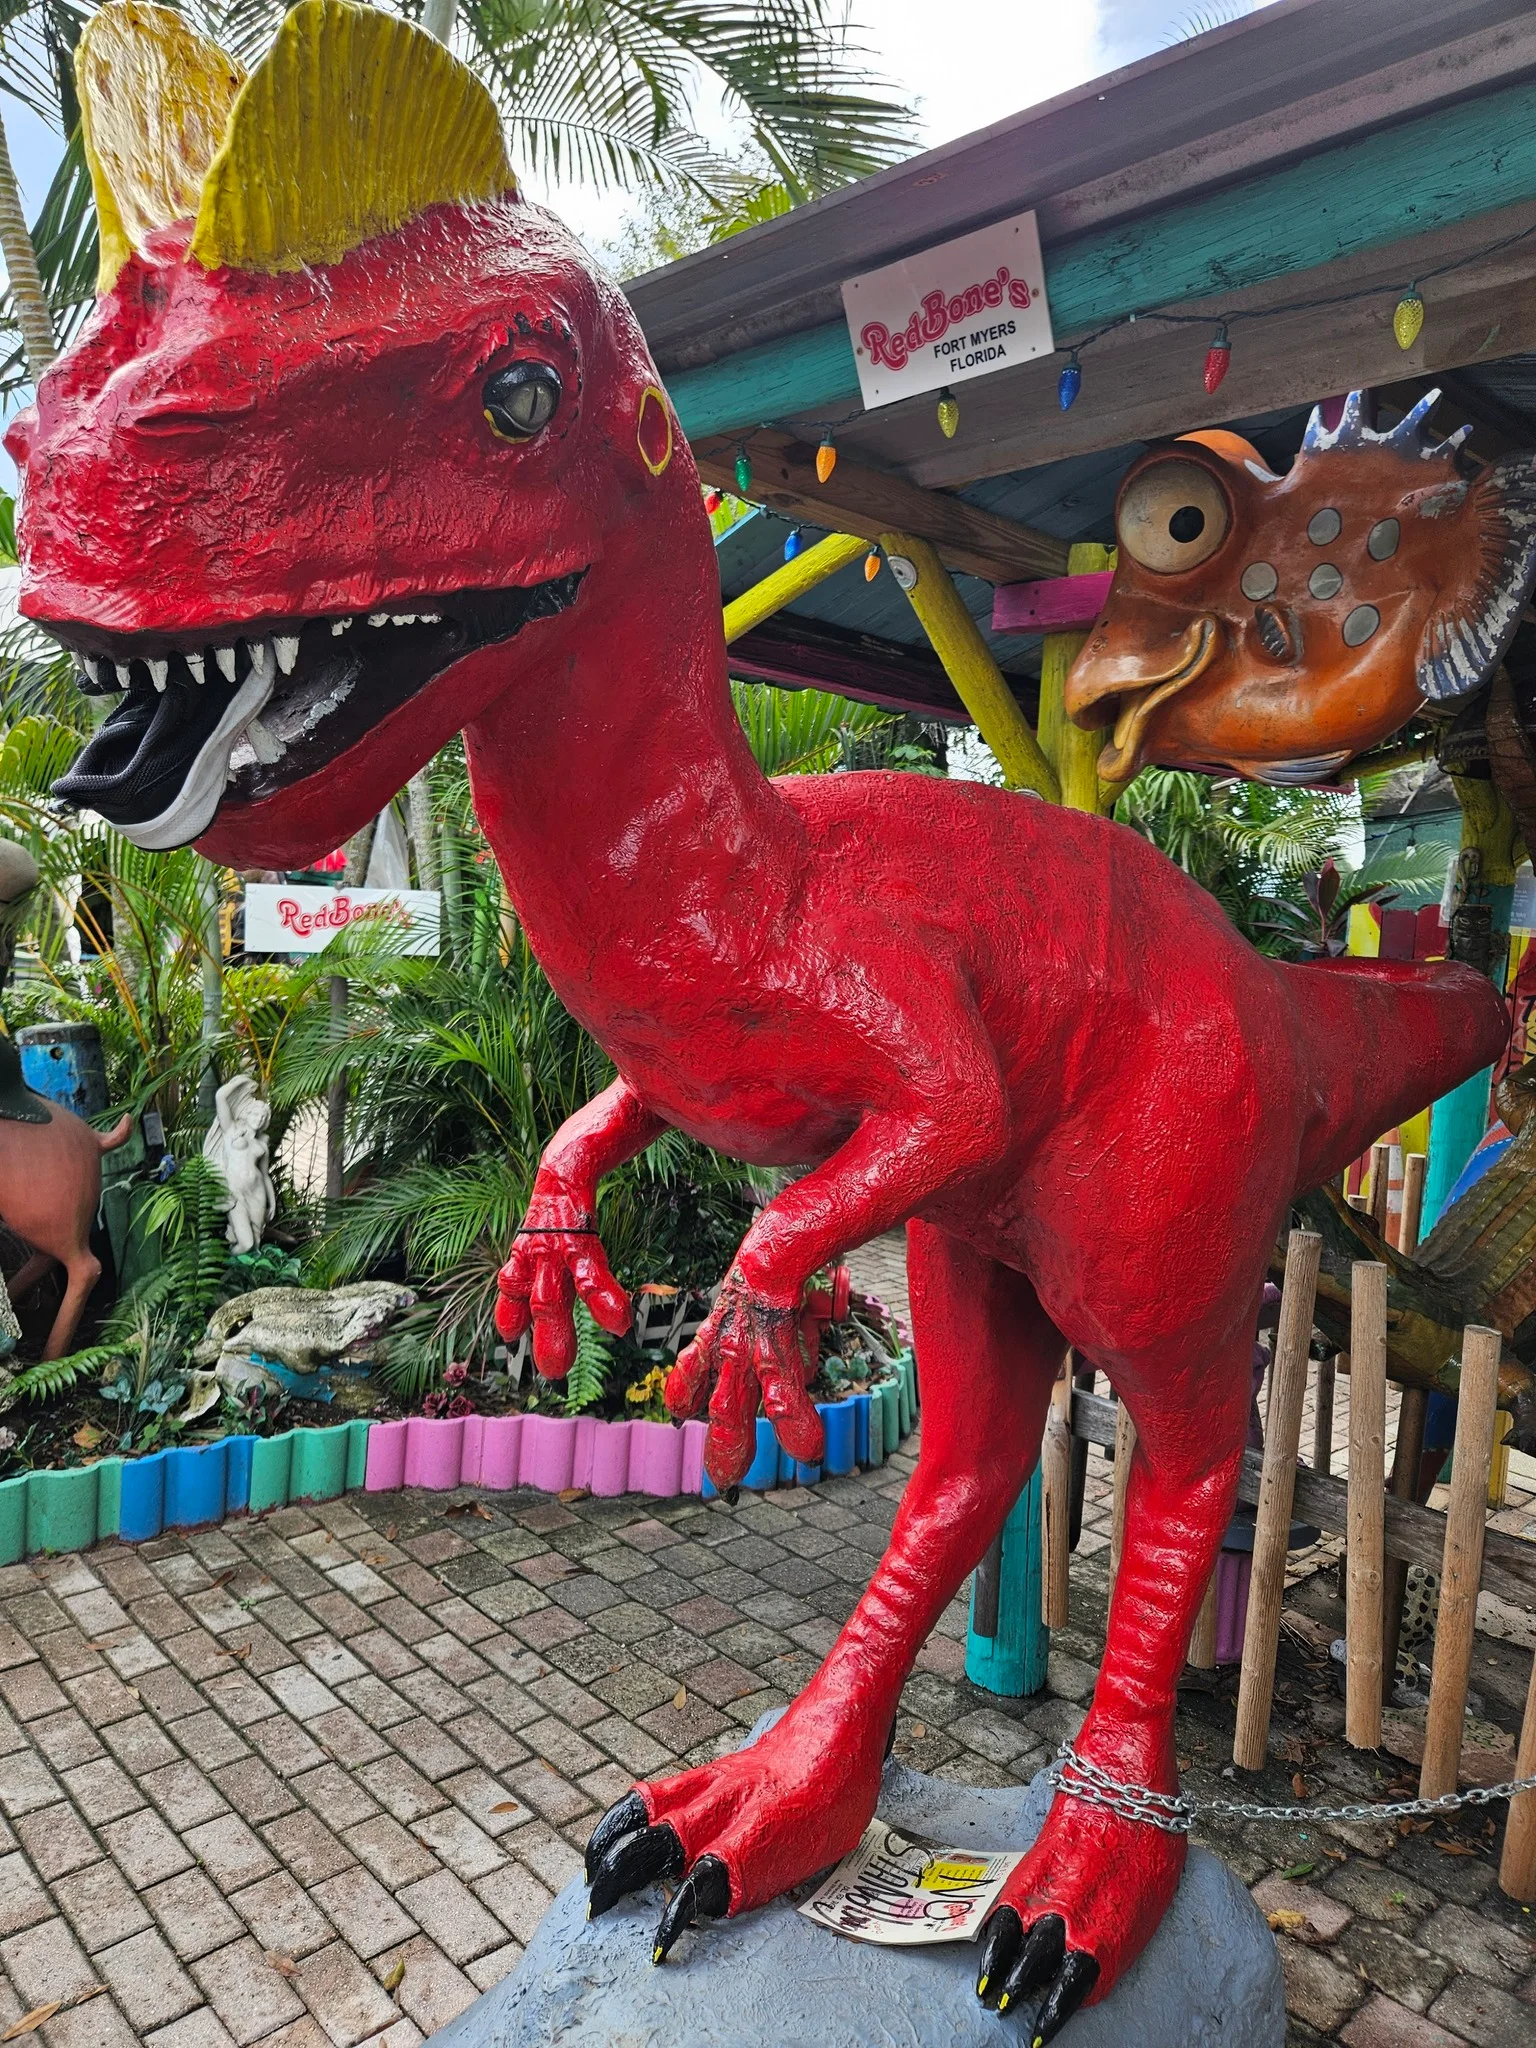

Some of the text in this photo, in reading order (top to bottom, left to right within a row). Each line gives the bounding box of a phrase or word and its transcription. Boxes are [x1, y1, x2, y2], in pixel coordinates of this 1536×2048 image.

[861, 266, 1031, 371] RedBone's
[933, 320, 1017, 359] FORT MYERS
[950, 344, 1007, 372] FLORIDA
[923, 1874, 997, 1920] NO
